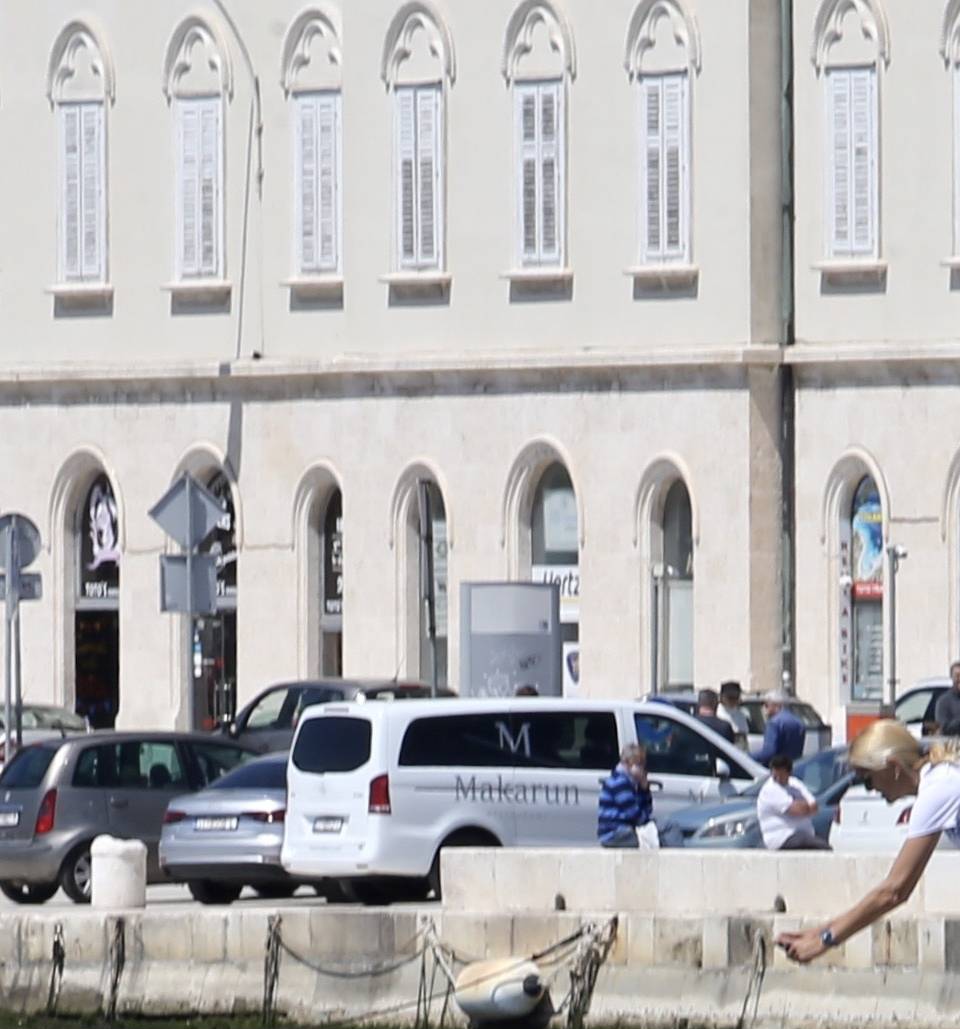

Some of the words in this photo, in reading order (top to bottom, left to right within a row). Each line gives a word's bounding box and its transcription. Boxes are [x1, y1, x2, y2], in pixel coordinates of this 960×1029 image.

[841, 542, 849, 597] RET
[495, 720, 531, 758] M
[455, 775, 579, 805] Makarun
